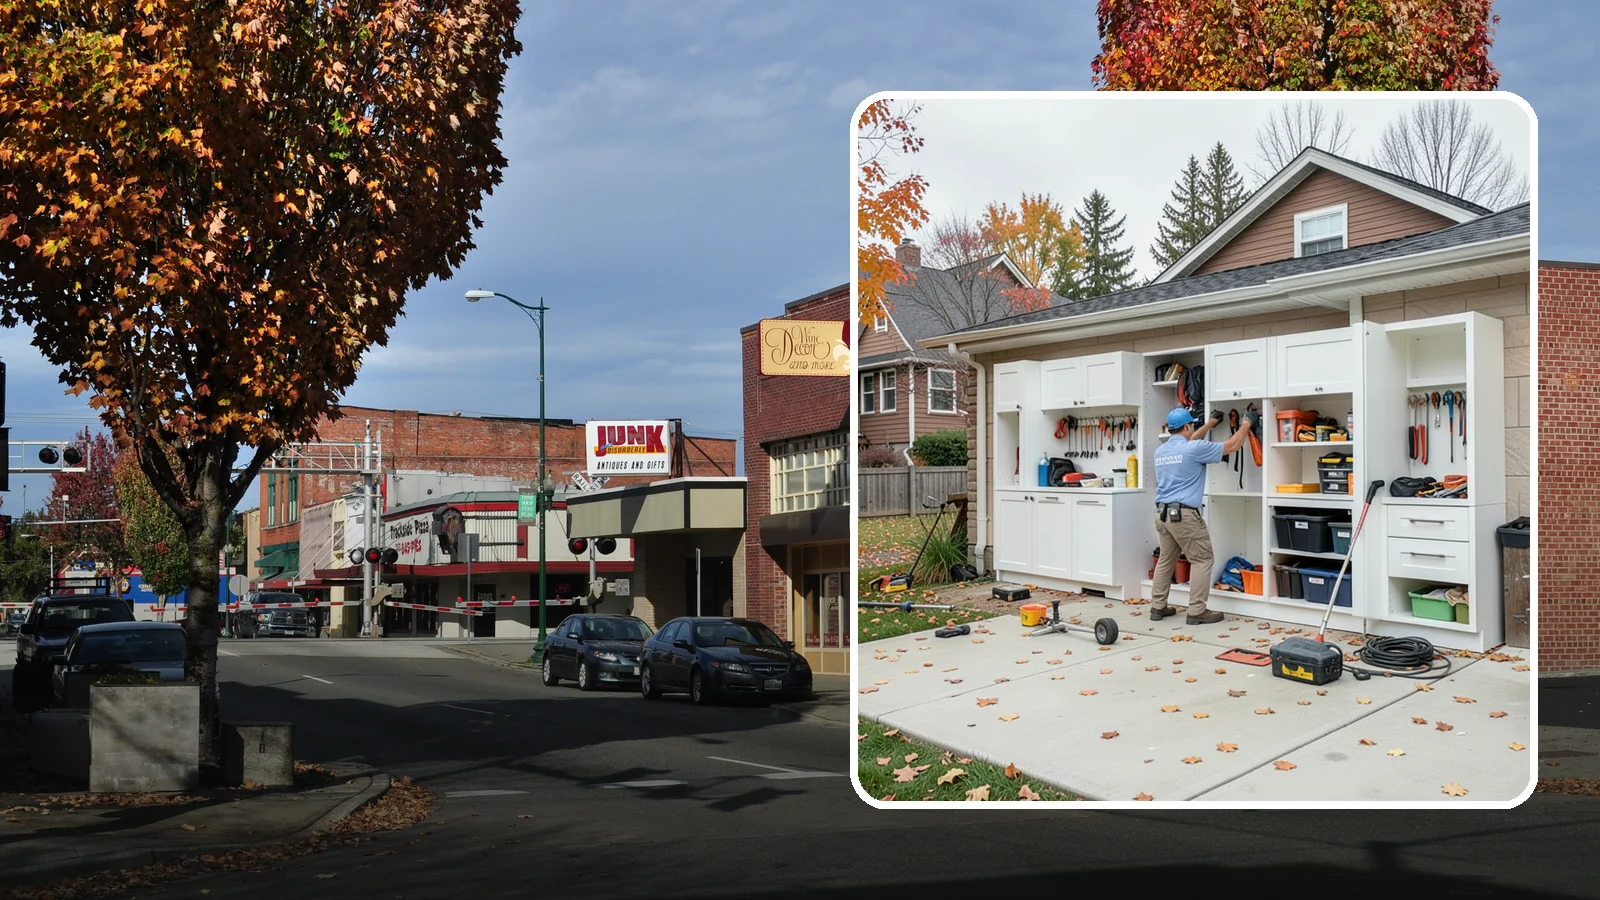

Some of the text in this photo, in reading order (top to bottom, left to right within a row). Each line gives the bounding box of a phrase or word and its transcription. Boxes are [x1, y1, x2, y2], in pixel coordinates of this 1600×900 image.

[596, 425, 665, 457] JUNK
[607, 446, 646, 454] DISORDERLY
[597, 461, 665, 470] ANTIQUES AND GIFTS
[390, 519, 429, 539] Trackside Pizza
